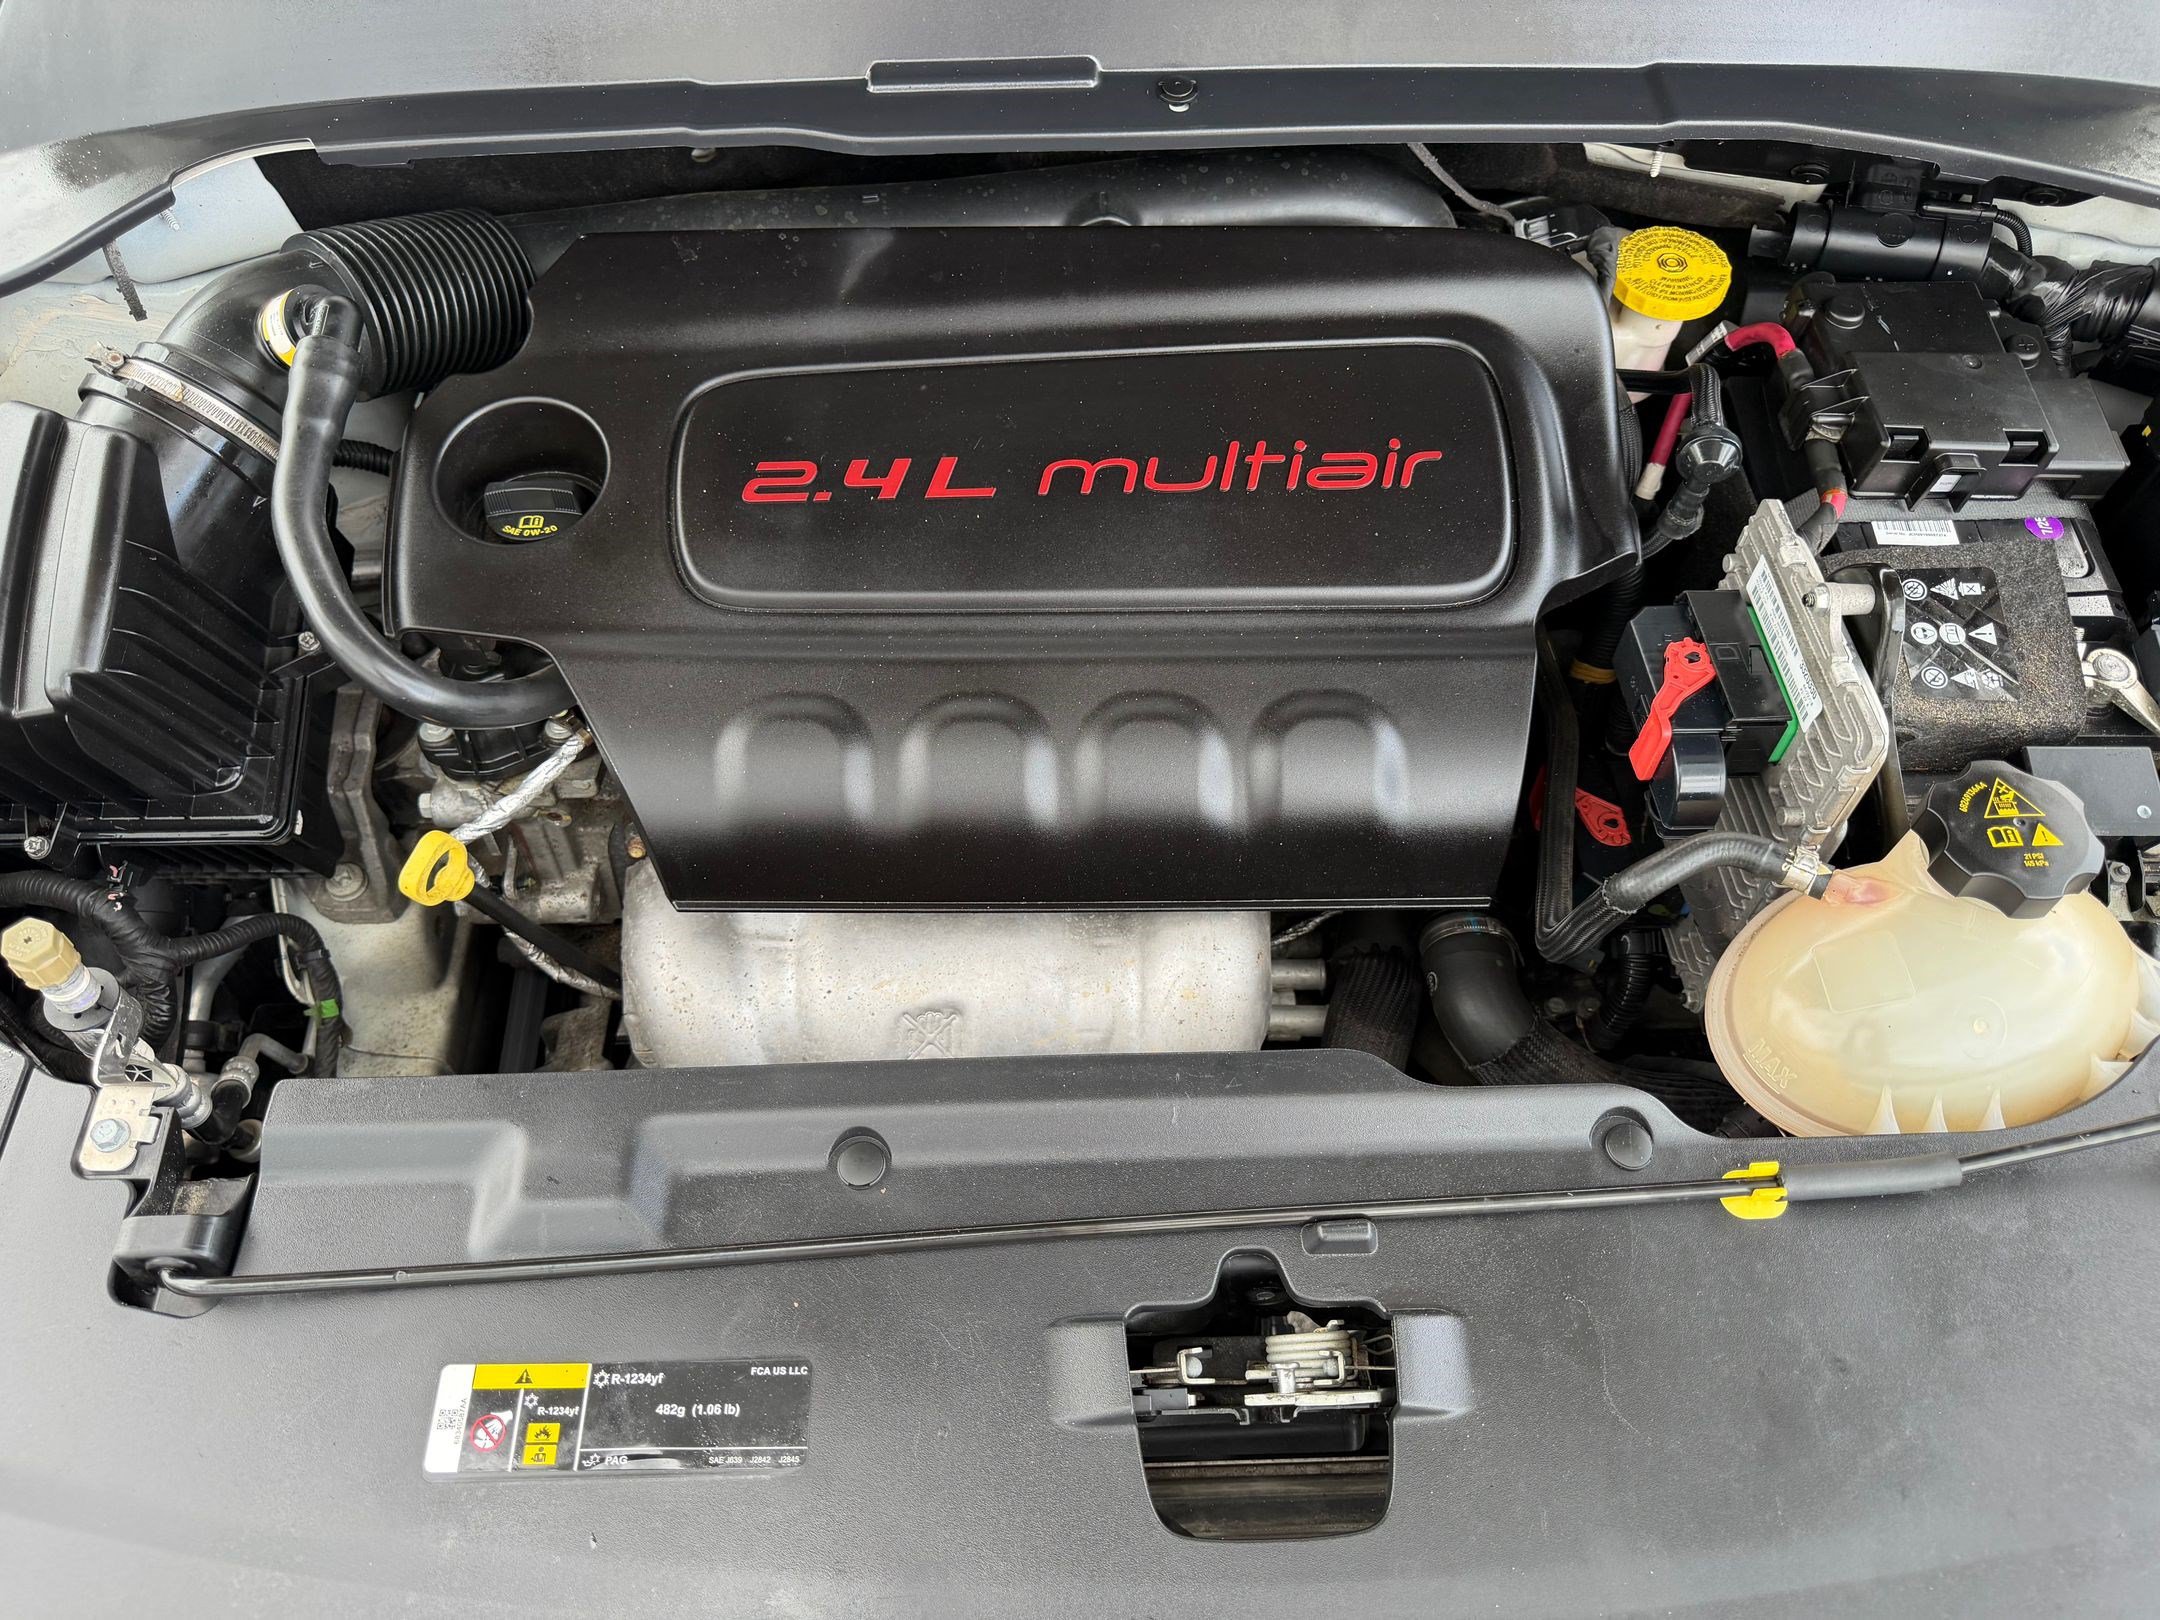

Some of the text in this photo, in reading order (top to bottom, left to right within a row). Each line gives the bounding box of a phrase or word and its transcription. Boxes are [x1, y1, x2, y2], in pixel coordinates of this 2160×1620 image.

[1038, 438, 1442, 496] multiair
[502, 525, 558, 537] SAE 0W-20
[1748, 1038, 1798, 1089] MAX
[751, 1366, 808, 1376] FCA US LLC
[611, 1373, 664, 1386] R-1234yf
[537, 1406, 580, 1417] R-1234yf
[655, 1403, 741, 1418] 482g (1.06 lb)
[605, 1455, 628, 1465] PAG
[708, 1456, 724, 1464] SAE
[750, 1456, 771, 1464] J2842
[778, 1456, 800, 1464] J2845
